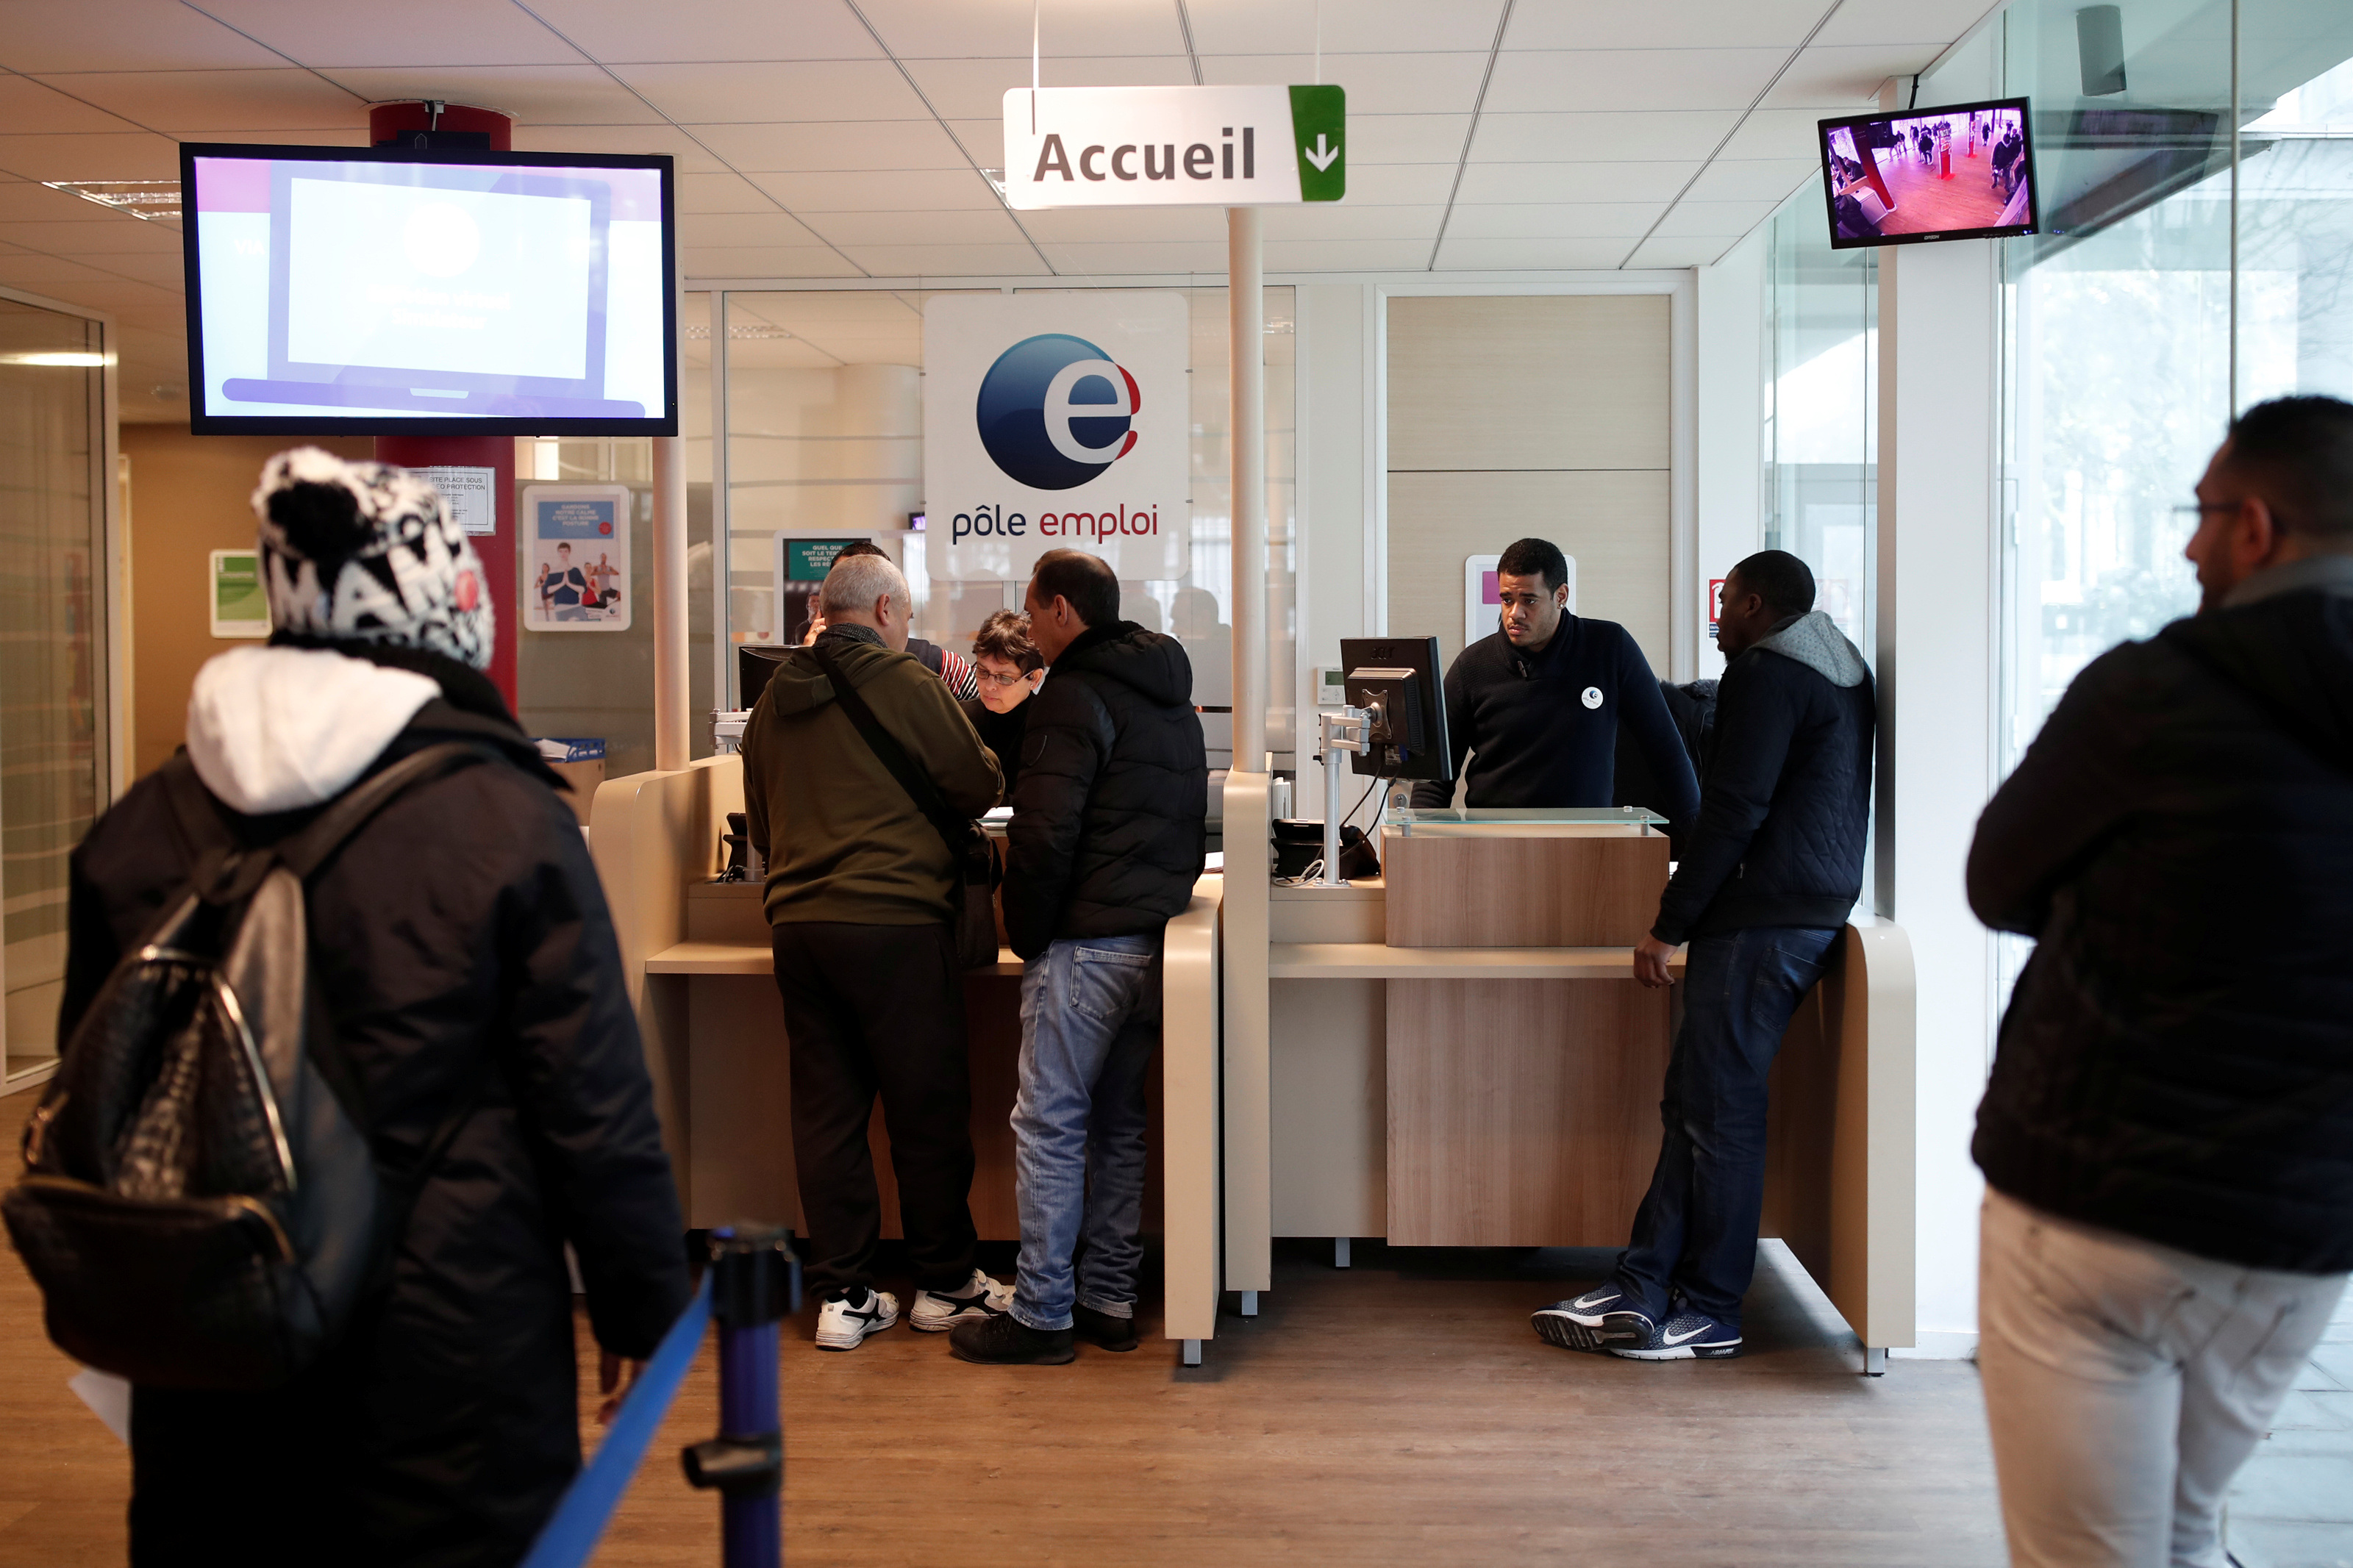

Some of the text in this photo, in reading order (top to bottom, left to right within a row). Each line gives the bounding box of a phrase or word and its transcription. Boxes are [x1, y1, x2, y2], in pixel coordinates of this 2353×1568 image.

[1033, 127, 1254, 182] Accueil
[233, 239, 265, 255] VIA
[952, 503, 1157, 545] pôle emploi
